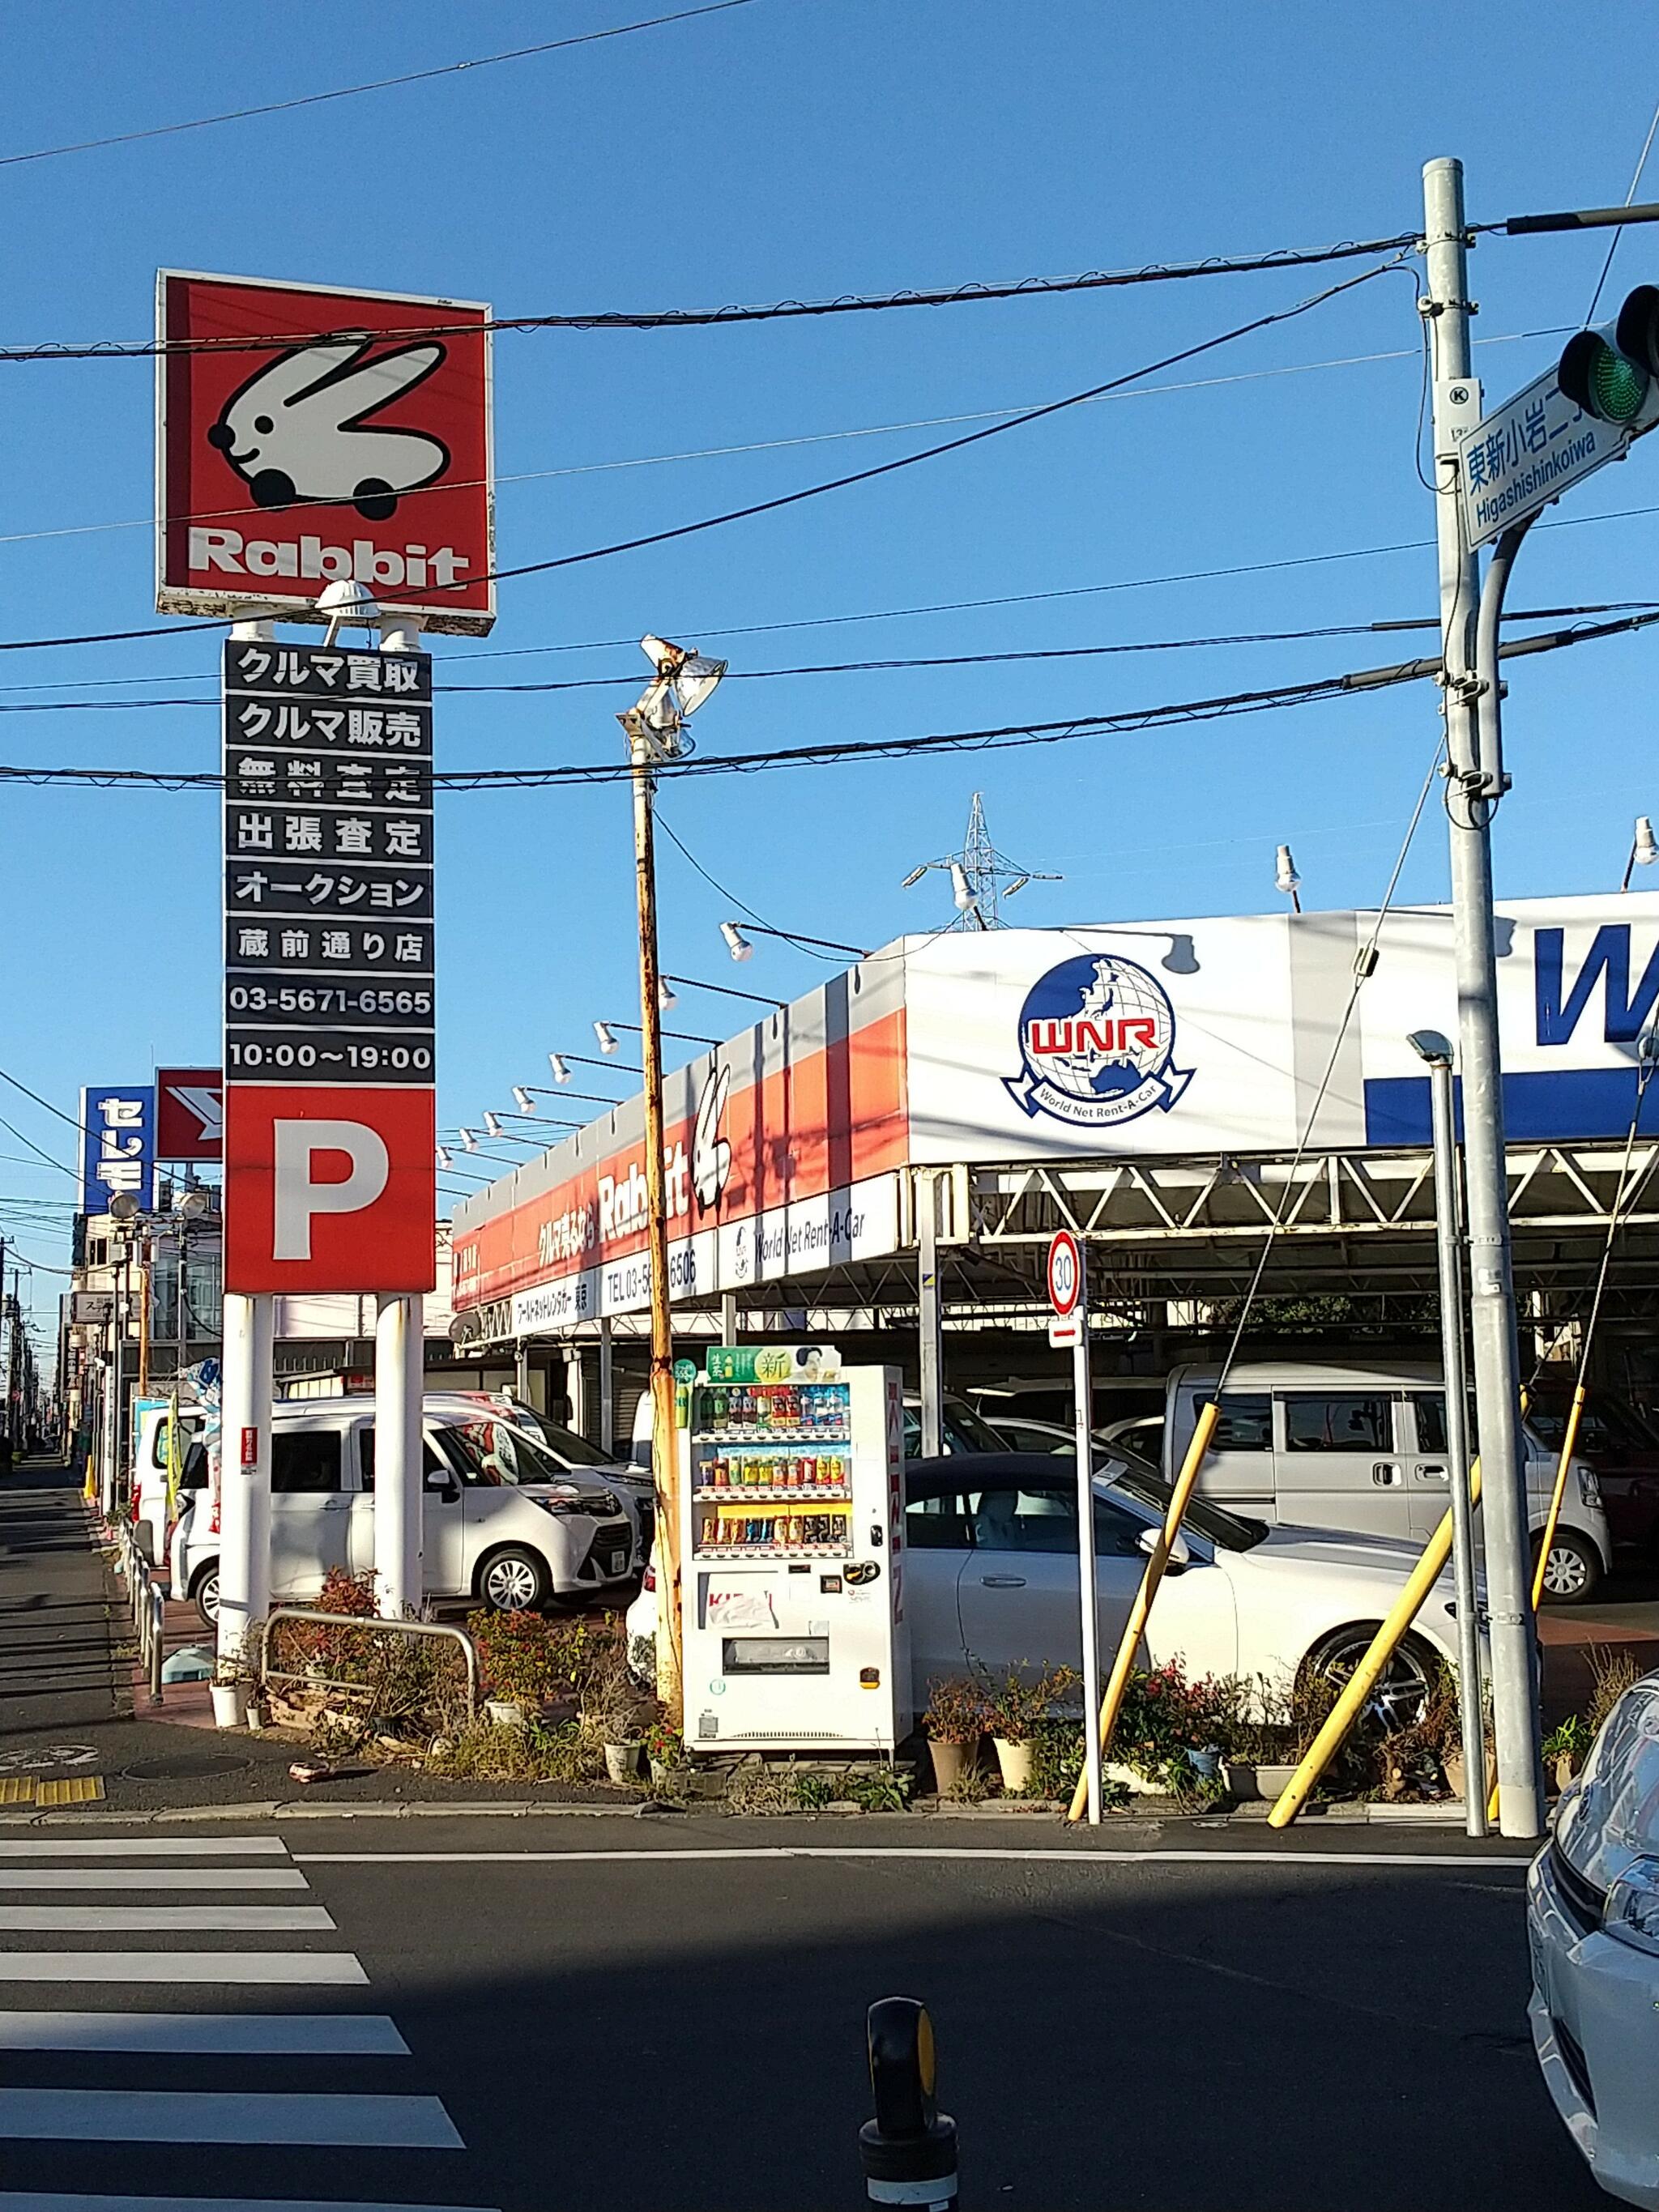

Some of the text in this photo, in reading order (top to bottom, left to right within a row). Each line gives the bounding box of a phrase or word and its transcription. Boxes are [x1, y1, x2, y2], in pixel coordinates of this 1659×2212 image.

[1476, 430, 1596, 527] Higashishinkoiwa
[188, 526, 469, 590] Rabbit
[237, 647, 420, 693] クルマ買取
[237, 702, 422, 748] クルマ販売
[237, 812, 422, 856] 出張査定
[235, 871, 424, 908] オークション
[237, 928, 424, 962] 蔵前通り店
[229, 987, 432, 1014] 03-5671-6565
[1031, 1018, 1159, 1054] WNR
[1039, 1085, 1157, 1118] World Net Rent-A-Car
[273, 1119, 390, 1260] P
[598, 1141, 689, 1243] Rabit
[755, 1208, 865, 1263] World Net Rent-A-Car
[608, 1272, 625, 1302] TEL
[1056, 1255, 1072, 1291] 30
[762, 1353, 786, 1379] 新
